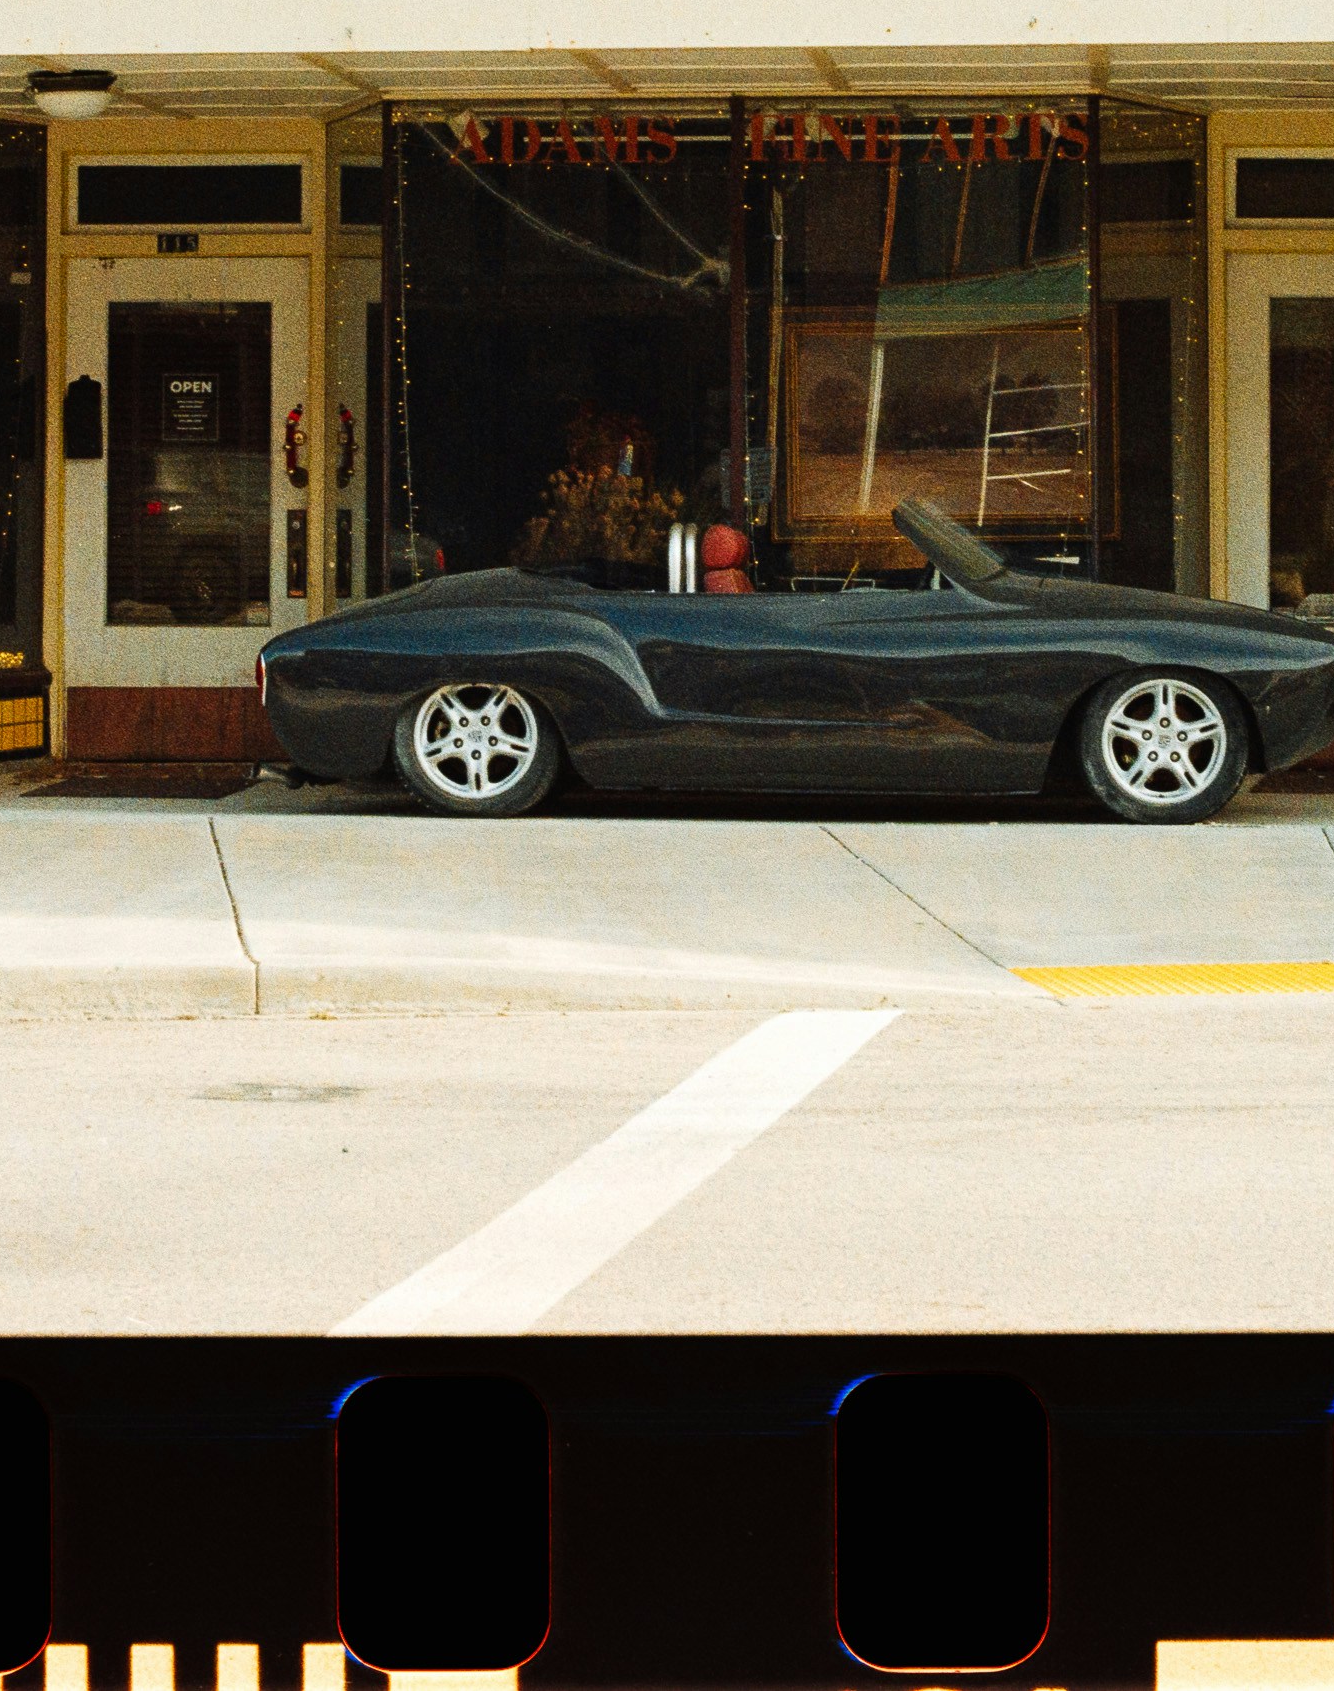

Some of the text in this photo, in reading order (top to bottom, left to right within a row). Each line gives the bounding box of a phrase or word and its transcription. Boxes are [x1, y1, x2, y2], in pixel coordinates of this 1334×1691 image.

[453, 111, 1090, 166] ADAMS FINE ARTS
[170, 381, 212, 394] OPEN
